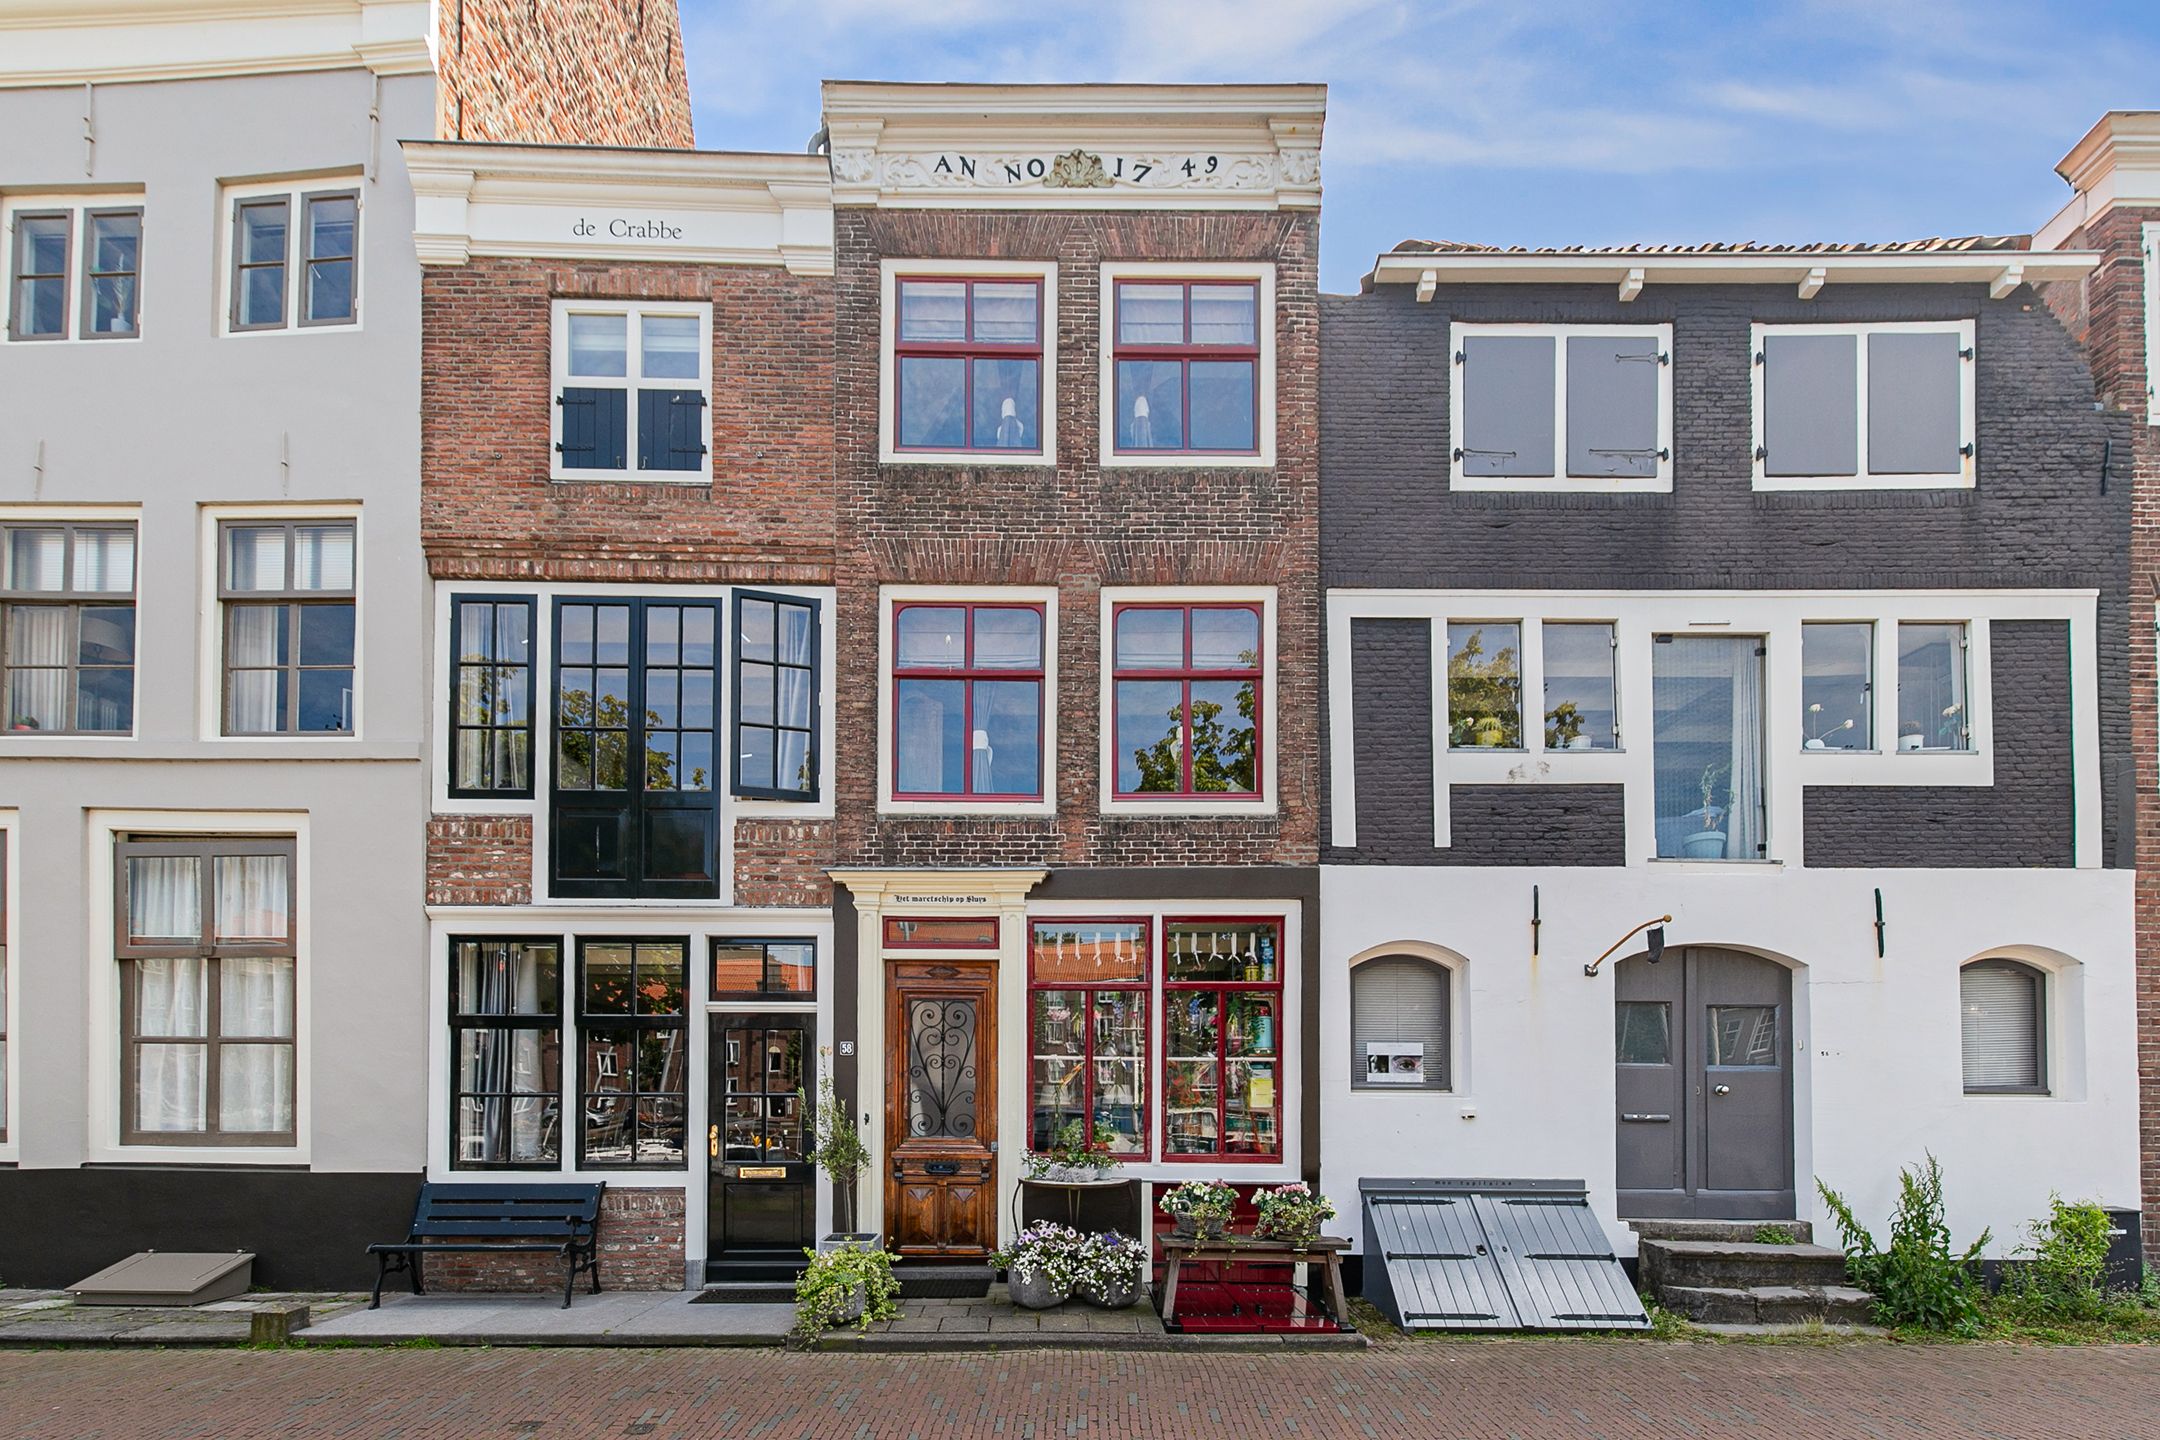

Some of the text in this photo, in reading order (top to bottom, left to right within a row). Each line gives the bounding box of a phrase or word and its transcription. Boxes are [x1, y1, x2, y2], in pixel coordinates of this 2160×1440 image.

[572, 218, 683, 239] de Crabbe
[955, 896, 964, 904] op
[841, 1043, 852, 1054] 58
